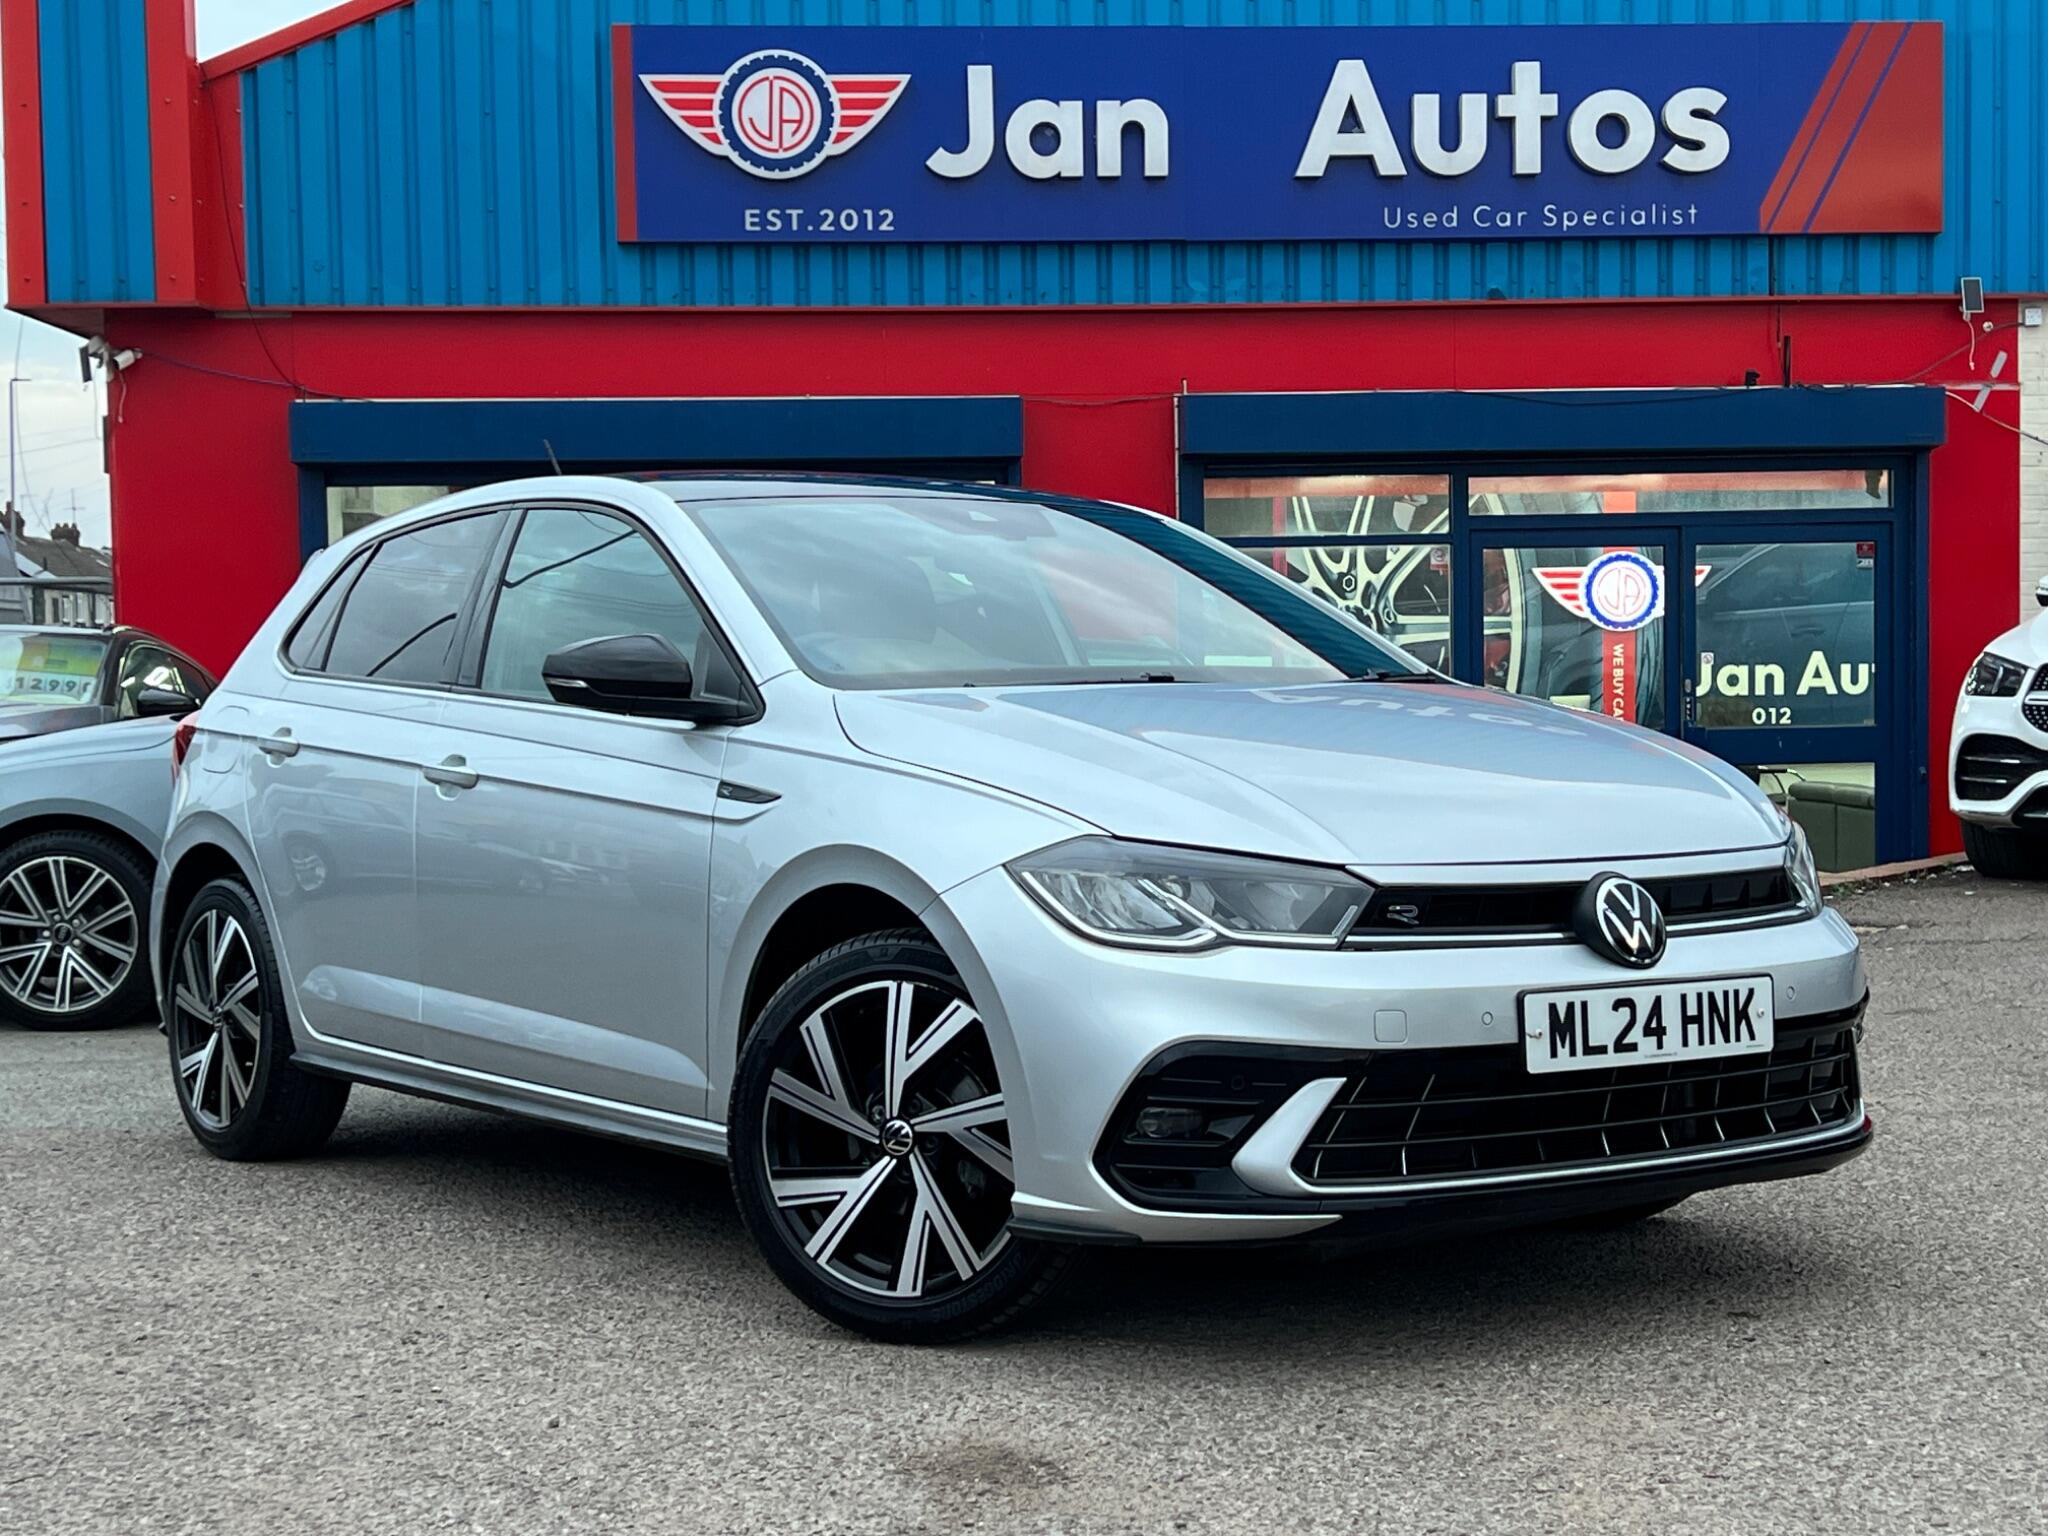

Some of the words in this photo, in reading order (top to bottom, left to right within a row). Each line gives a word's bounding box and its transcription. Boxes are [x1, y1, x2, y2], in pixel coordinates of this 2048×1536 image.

[925, 64, 1169, 179] Jan
[1294, 59, 1731, 178] Autos
[744, 208, 896, 232] EST.2012
[1383, 205, 1458, 228] Used
[1473, 205, 1528, 227] Car
[1542, 203, 1698, 231] Specialist
[1612, 643, 1625, 666] WE
[1612, 667, 1625, 696] BUY
[1695, 651, 1785, 697] Jan
[1796, 650, 1875, 695] Au
[1547, 995, 1667, 1059] ML24
[1680, 987, 1757, 1048] HNK
